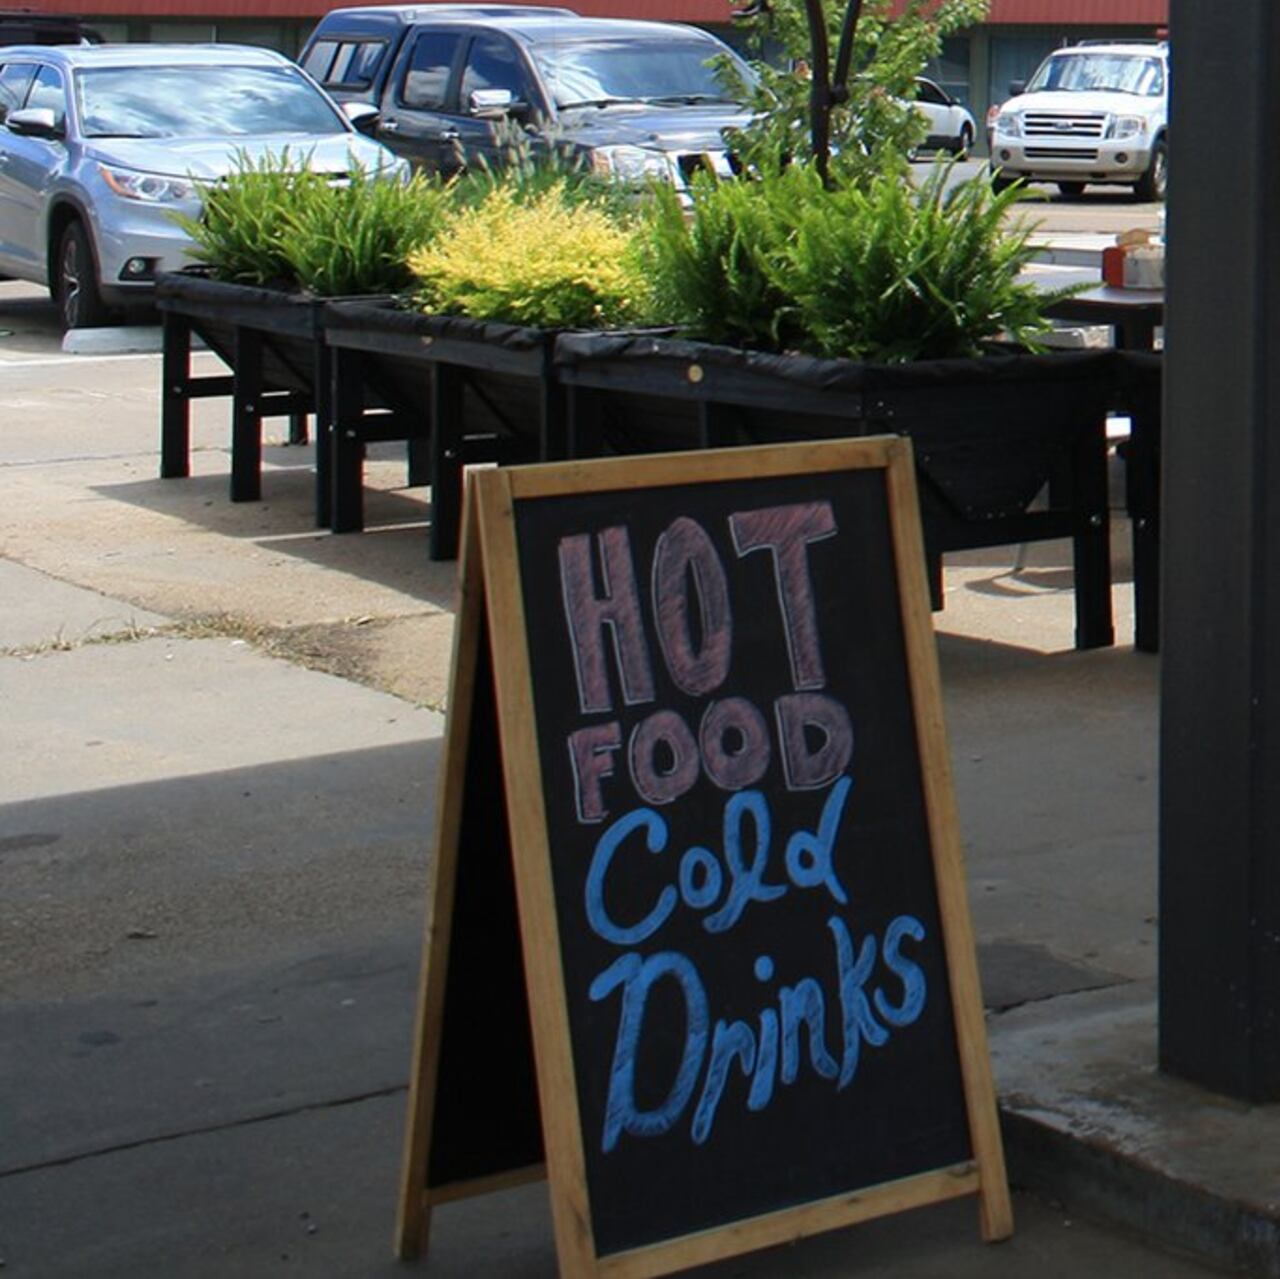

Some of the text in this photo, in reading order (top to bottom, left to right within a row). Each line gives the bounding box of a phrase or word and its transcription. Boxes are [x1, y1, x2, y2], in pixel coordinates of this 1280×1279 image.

[558, 500, 838, 715] HOT
[567, 693, 854, 824] FOOD
[585, 775, 852, 945] Cold
[588, 915, 928, 1154] Drinks
